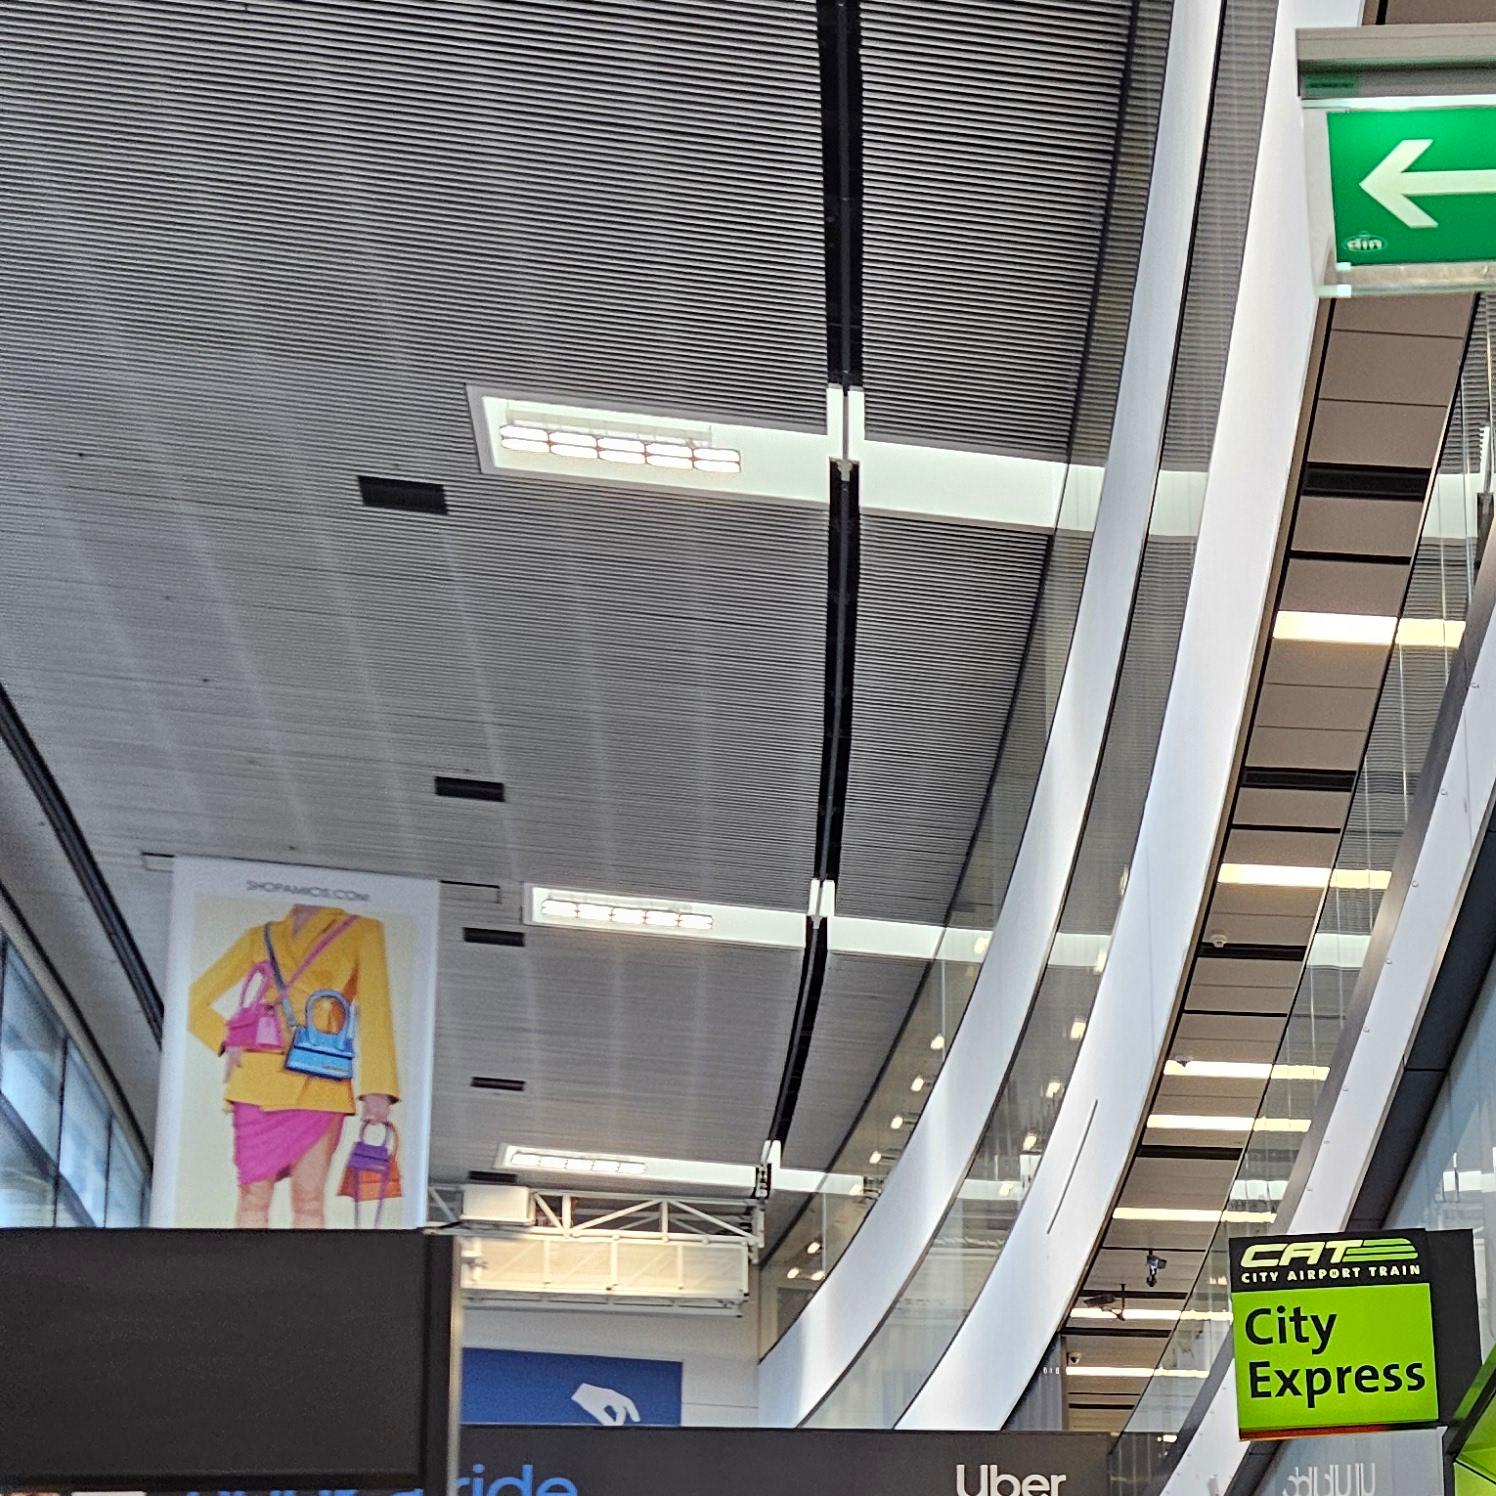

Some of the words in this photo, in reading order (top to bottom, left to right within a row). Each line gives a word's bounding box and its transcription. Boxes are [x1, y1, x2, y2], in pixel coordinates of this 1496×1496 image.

[1241, 1271, 1279, 1284] CITY
[1287, 1266, 1362, 1281] AIRPORT
[1369, 1264, 1421, 1278] TRAIN
[1245, 1305, 1338, 1355] City
[1249, 1360, 1426, 1409] Express
